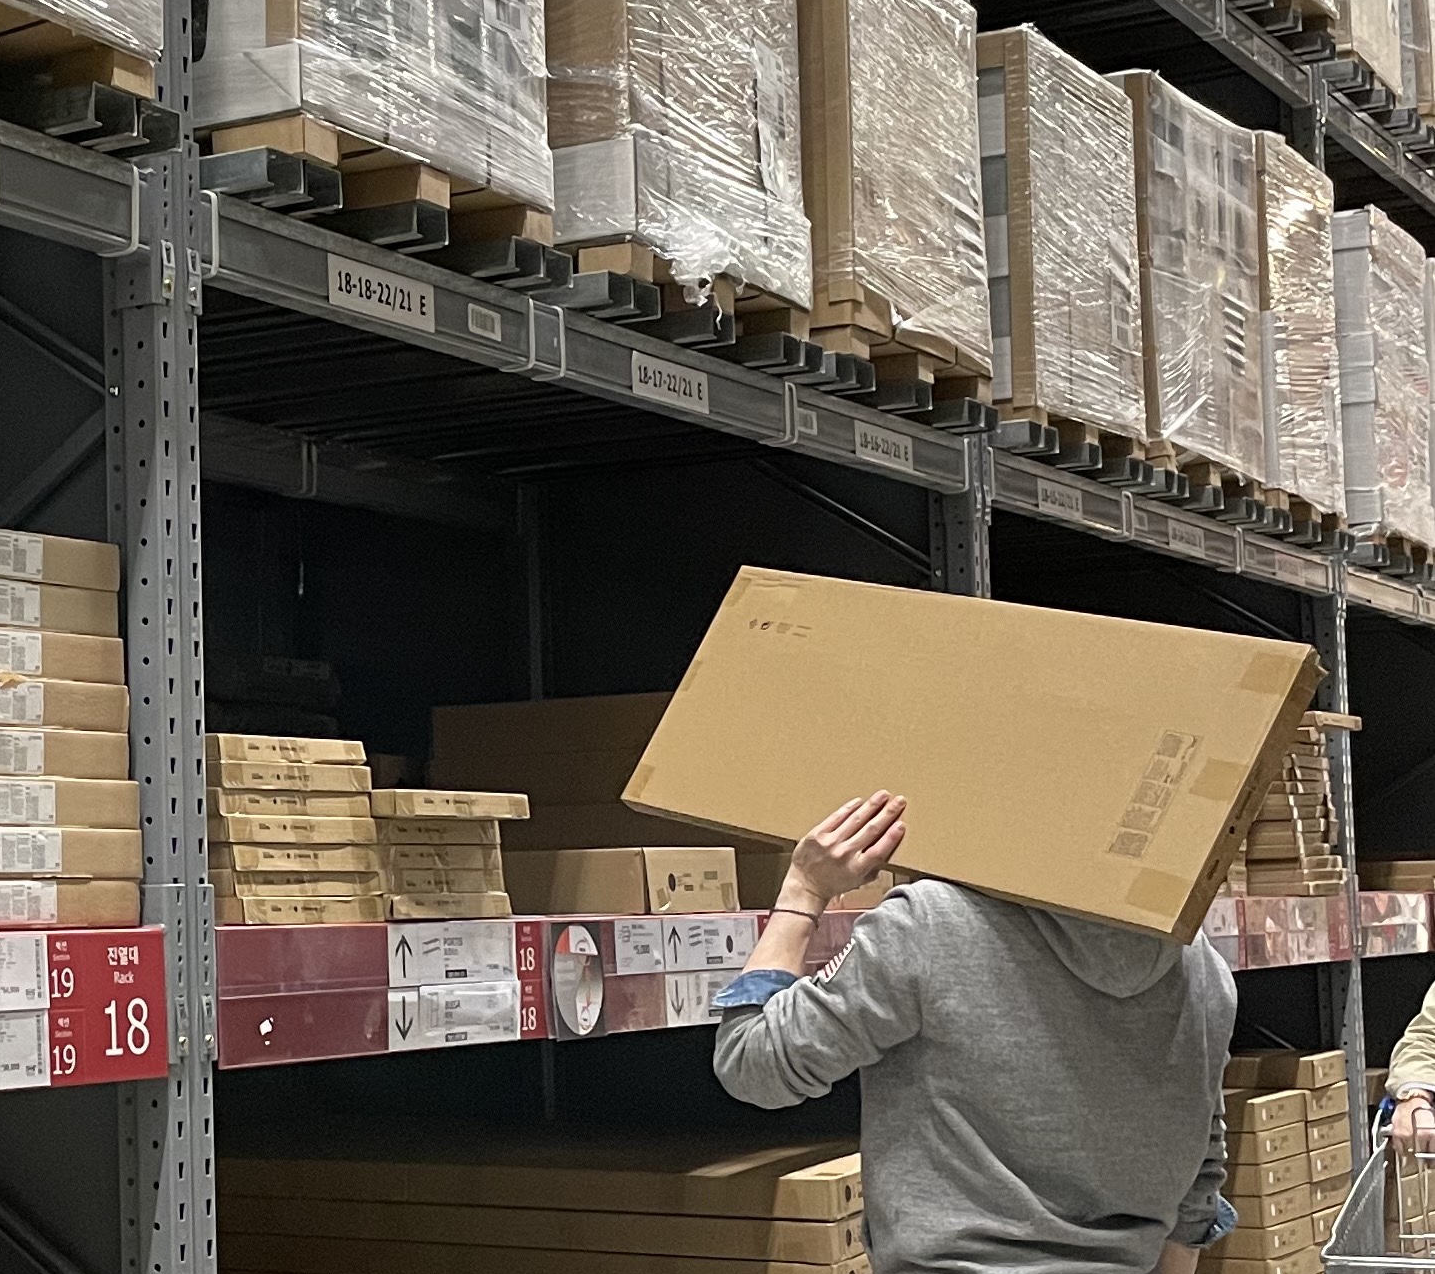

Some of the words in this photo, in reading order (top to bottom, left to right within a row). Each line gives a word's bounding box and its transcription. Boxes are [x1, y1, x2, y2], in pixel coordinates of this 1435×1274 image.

[337, 270, 412, 312] 18-18-22/21
[419, 294, 426, 316] E
[638, 365, 693, 398] 18-17-22/21
[697, 381, 703, 401] E
[107, 946, 140, 965] 진열대
[519, 946, 536, 971] 18
[51, 967, 75, 999] 19
[113, 970, 135, 984] Rack
[104, 997, 151, 1057] 18
[521, 1005, 537, 1031] 18
[52, 1043, 76, 1075] 19
